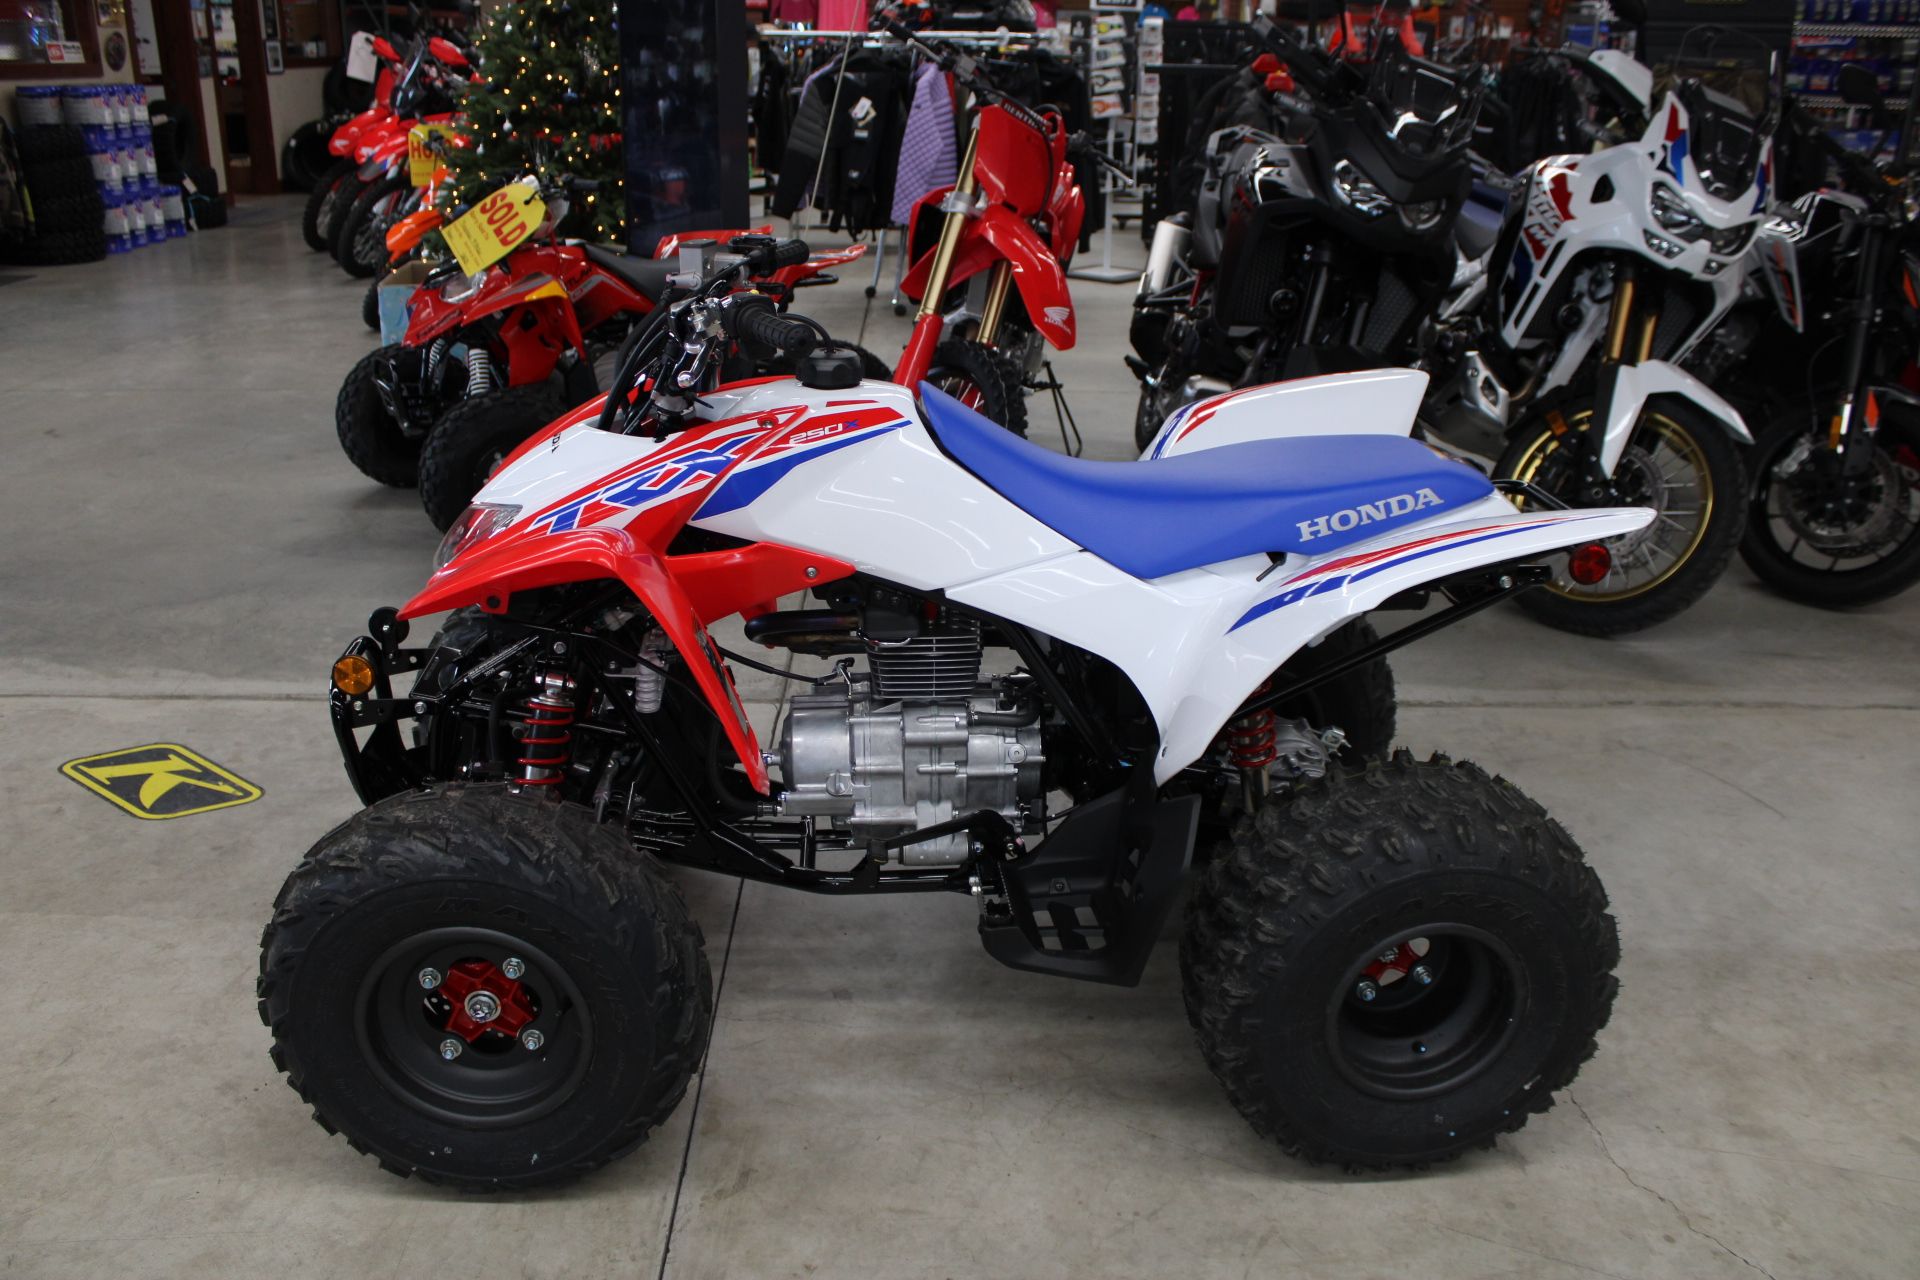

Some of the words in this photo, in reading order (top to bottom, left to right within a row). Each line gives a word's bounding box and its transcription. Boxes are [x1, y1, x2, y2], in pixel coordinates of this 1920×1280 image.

[479, 190, 526, 247] SOLD
[531, 433, 759, 534] TRX
[1296, 486, 1445, 542] HONDA
